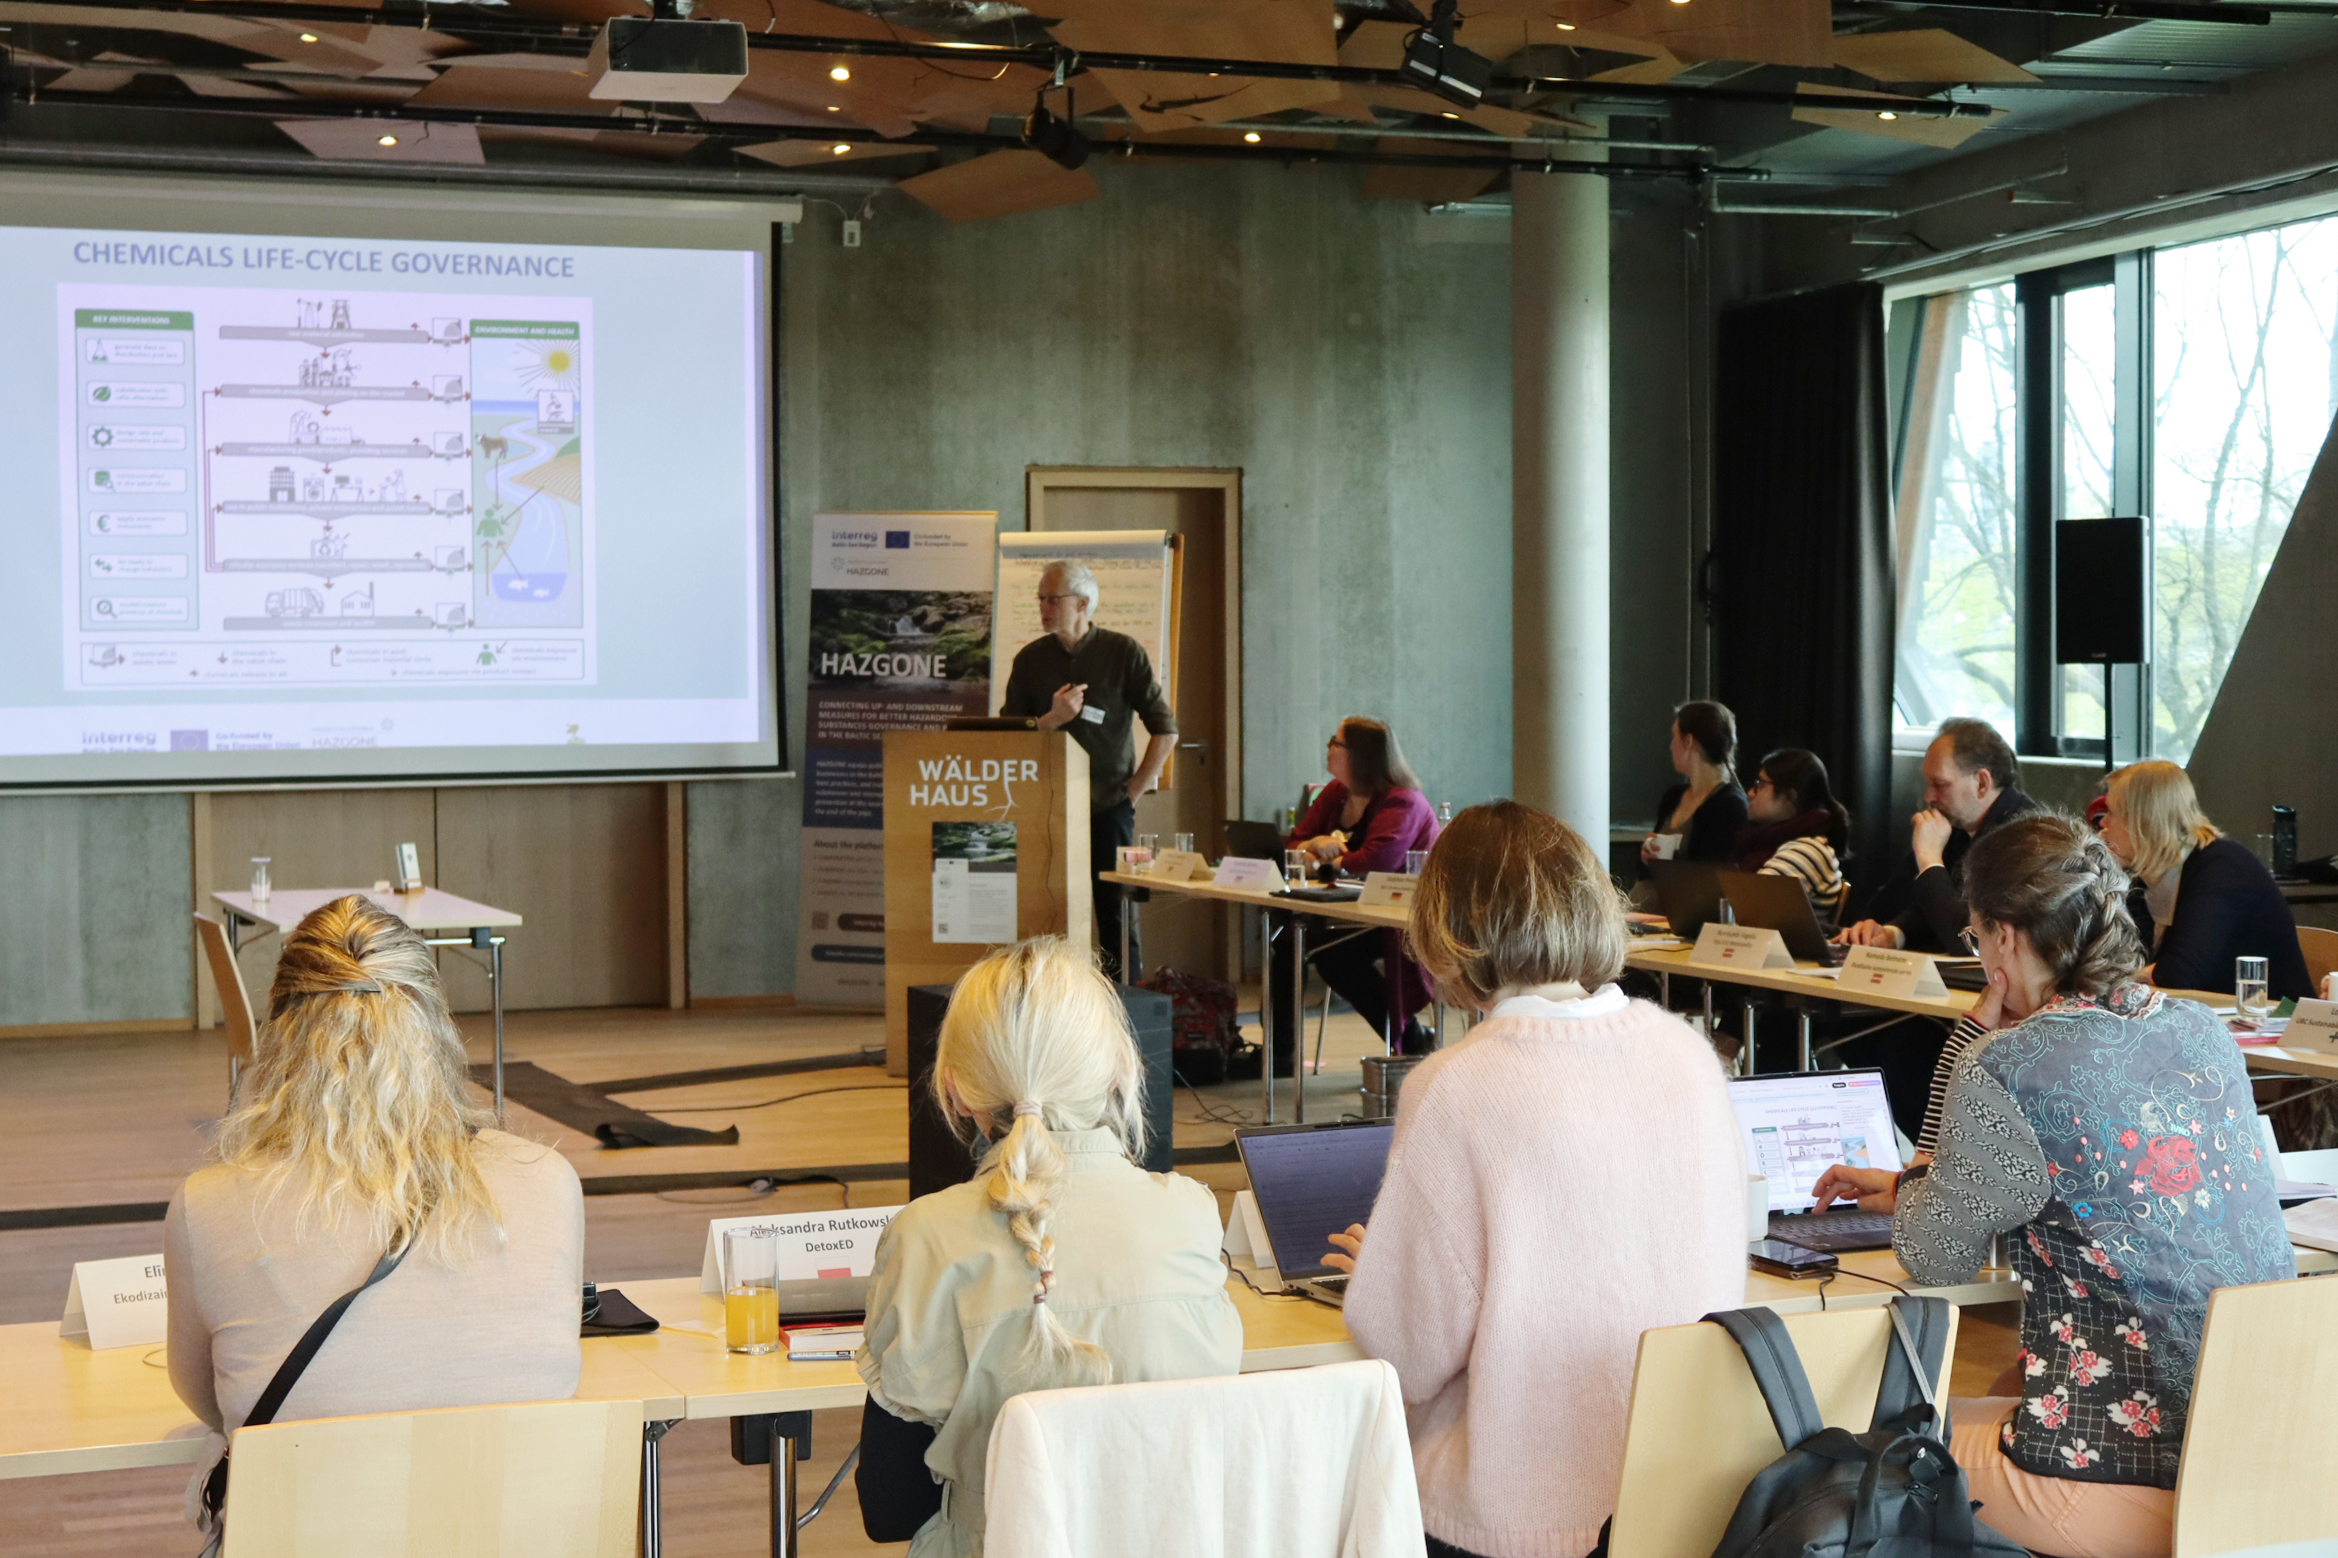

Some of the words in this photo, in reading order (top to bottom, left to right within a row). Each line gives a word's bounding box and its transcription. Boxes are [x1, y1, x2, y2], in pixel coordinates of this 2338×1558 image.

[73, 241, 234, 267] CHEMICALS
[243, 246, 383, 273] LIFE-CYCLE
[391, 252, 575, 278] GOVERNANCE
[475, 326, 528, 335] ENVIRONMENT
[846, 567, 890, 577] HAZGONE
[820, 652, 947, 678] HAZGONE
[818, 701, 869, 710] CONNECTING
[871, 703, 884, 711] UP-
[886, 703, 904, 711] AND
[905, 704, 964, 713] DOWNSTREAM
[818, 711, 861, 720] MEASURES
[862, 712, 878, 720] FOR
[879, 713, 908, 721] BETTER
[909, 713, 957, 722] HAZARDO
[818, 721, 867, 730] SUBSTANCES
[868, 722, 922, 731] GOVERNANCE
[923, 724, 942, 732] AND
[829, 731, 843, 739] THE
[845, 732, 871, 740] BALTIC
[312, 736, 378, 748] HAZGONE
[918, 754, 1039, 782] WÄLDER
[909, 784, 989, 807] HAUS
[814, 840, 838, 849] About
[840, 840, 853, 849] the
[805, 1239, 854, 1253] DetoxED
